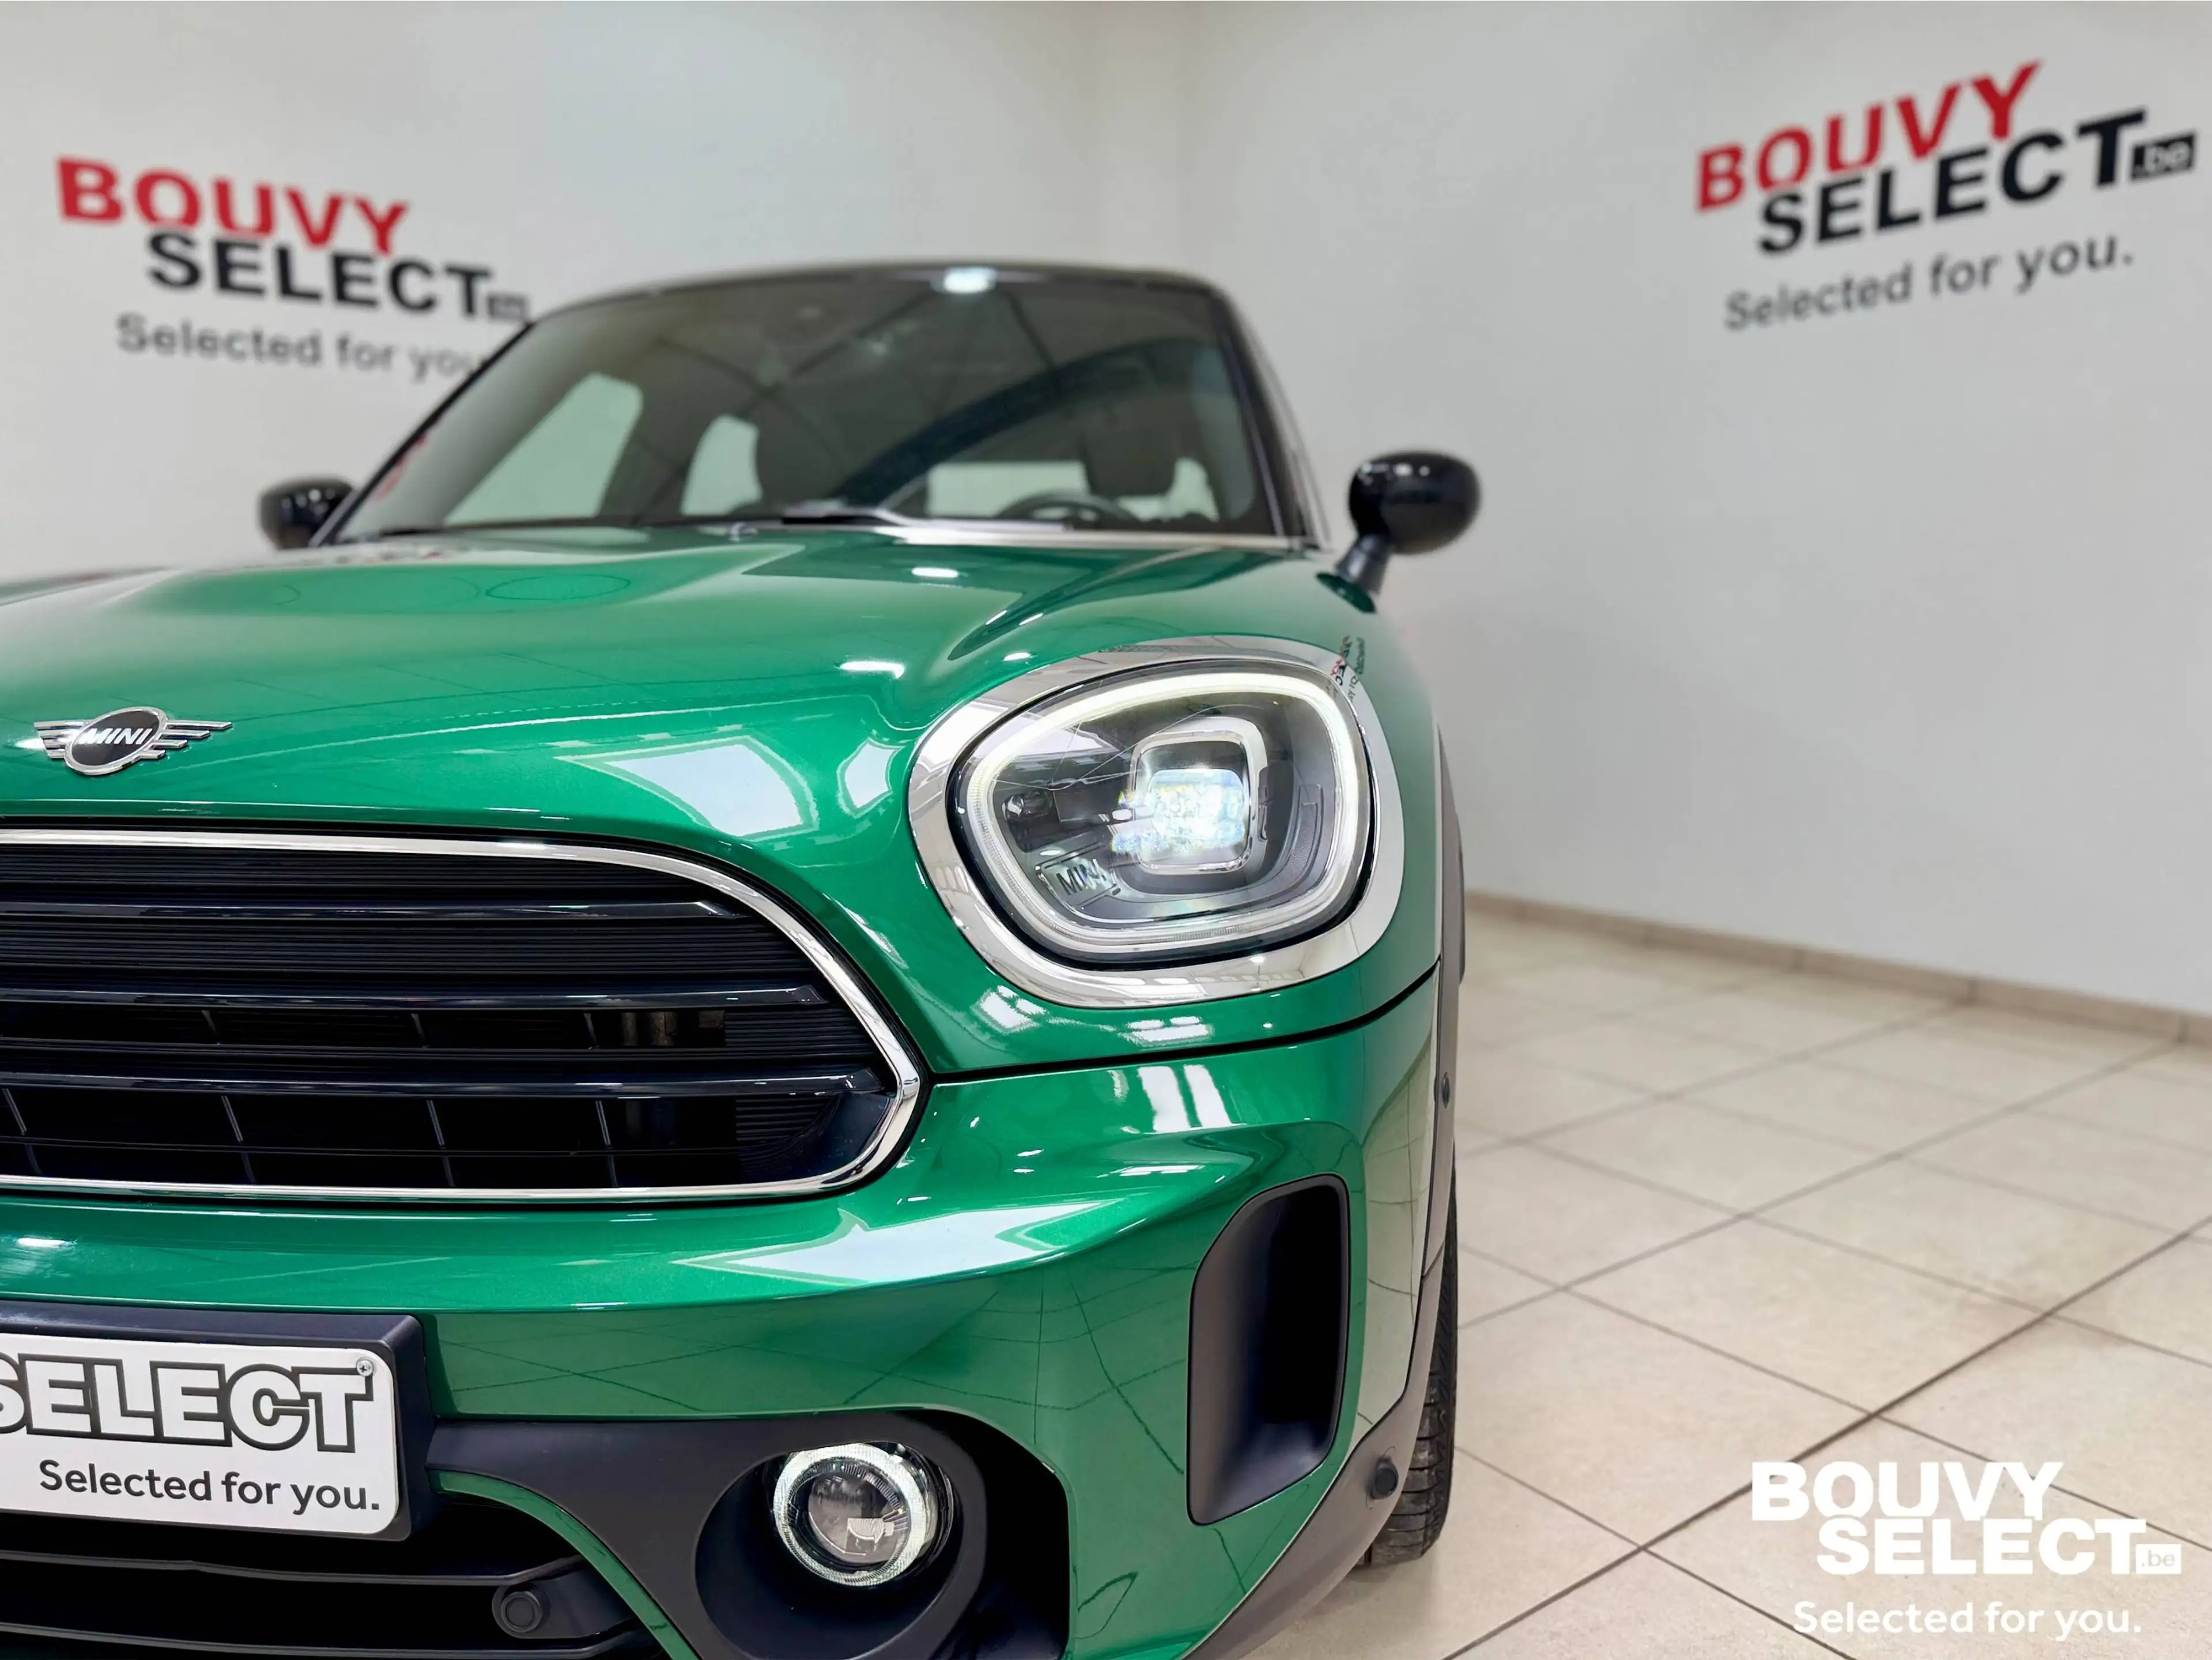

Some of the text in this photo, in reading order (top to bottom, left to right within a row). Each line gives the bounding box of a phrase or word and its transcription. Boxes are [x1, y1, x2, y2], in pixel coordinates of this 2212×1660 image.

[1696, 61, 2043, 213] BOUVY
[1758, 107, 2147, 256] SELECT
[56, 157, 409, 256] BOUVY
[147, 228, 492, 318] SELECT
[1725, 236, 2132, 331] Selected for you.
[117, 314, 323, 367] Selected
[337, 331, 395, 373] for
[78, 728, 153, 744] MINI
[39, 1459, 379, 1515] Selected for you.
